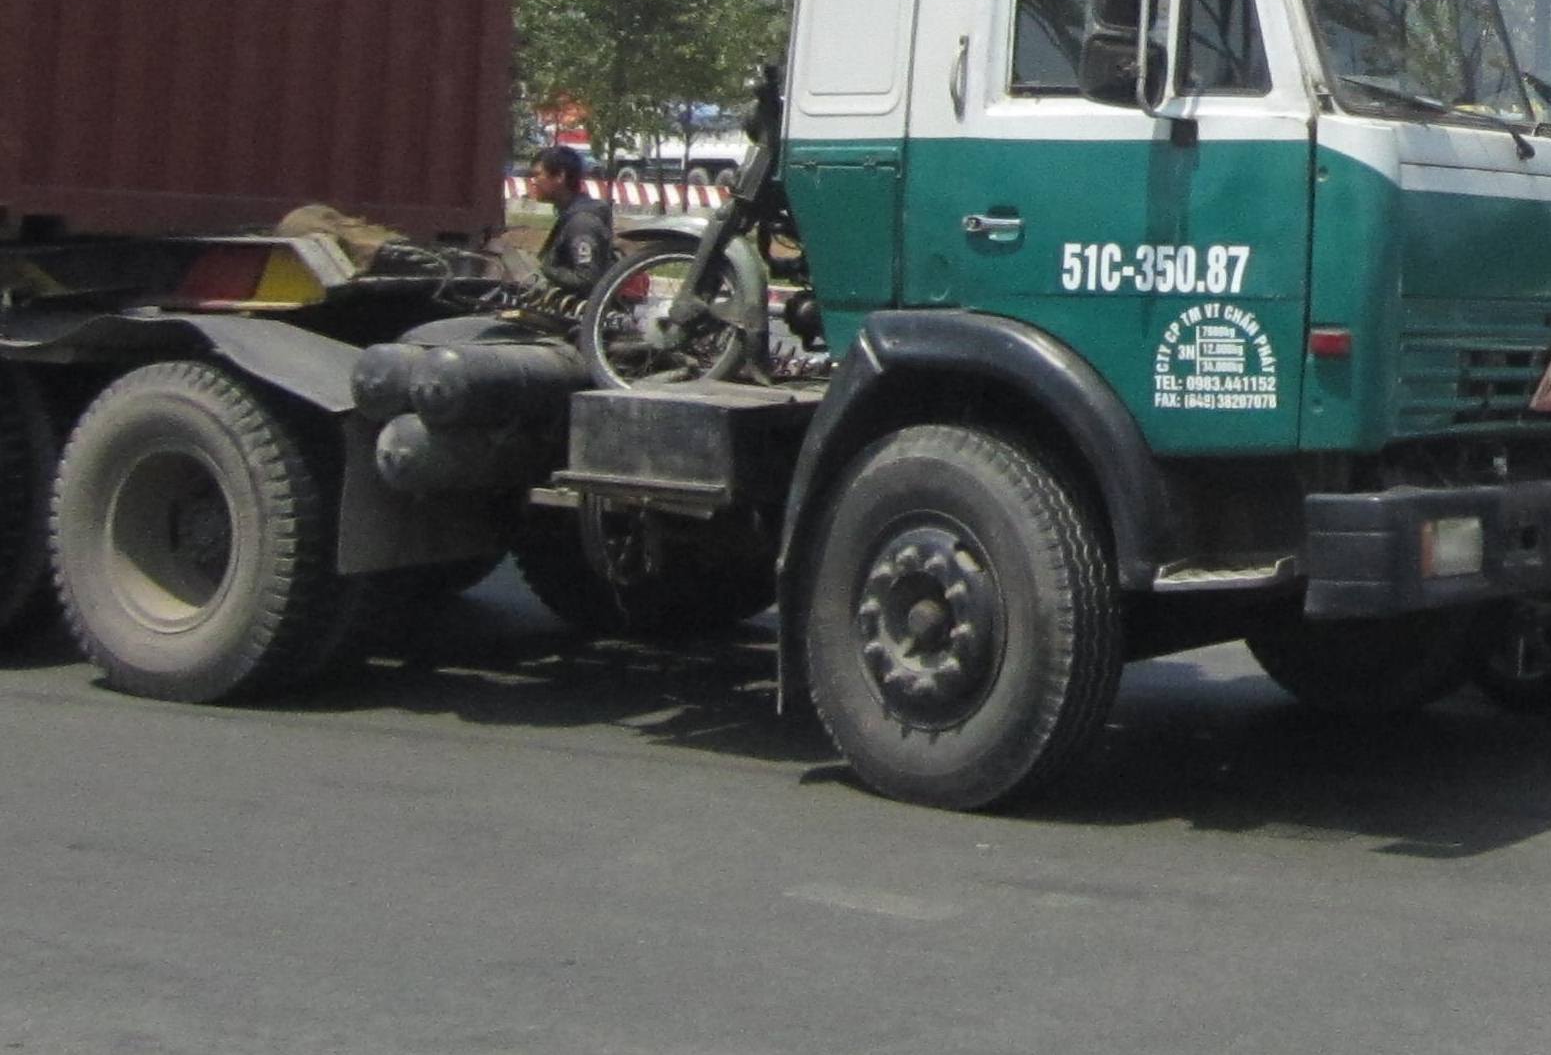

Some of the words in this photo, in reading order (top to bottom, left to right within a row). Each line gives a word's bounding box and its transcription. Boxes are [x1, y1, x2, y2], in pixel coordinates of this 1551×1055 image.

[1062, 243, 1250, 293] 51C-350.87
[1156, 344, 1172, 373] CTY
[1164, 322, 1181, 343] CP
[1180, 306, 1203, 327] TM
[1204, 303, 1220, 319] VT
[1154, 375, 1183, 391] TEL:
[1154, 392, 1181, 408] FAX:
